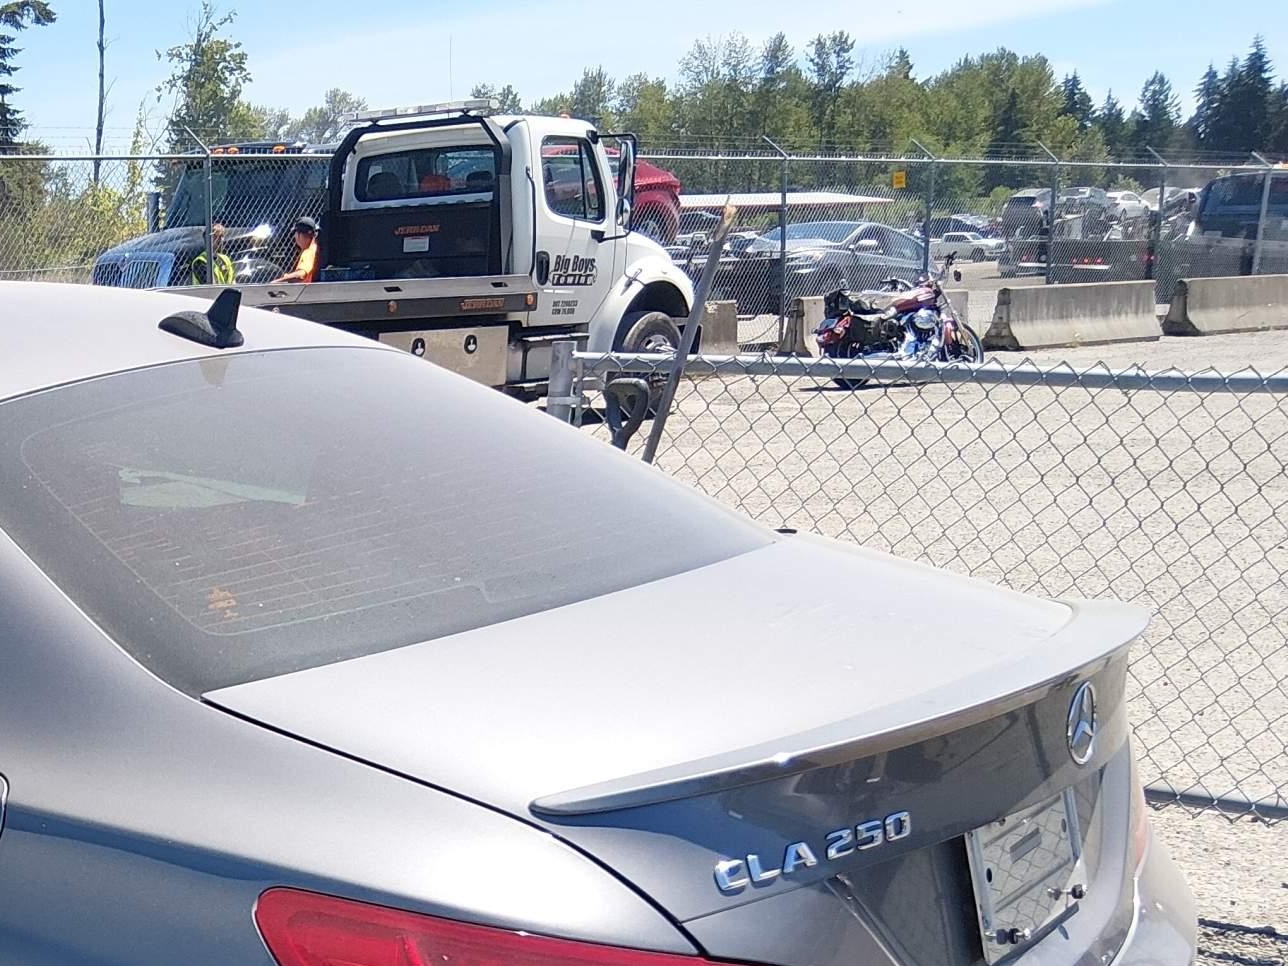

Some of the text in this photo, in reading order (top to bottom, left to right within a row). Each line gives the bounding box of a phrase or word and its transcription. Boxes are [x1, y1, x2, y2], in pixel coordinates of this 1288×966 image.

[553, 254, 596, 274] Big Boys
[714, 811, 911, 891] CLA 250
